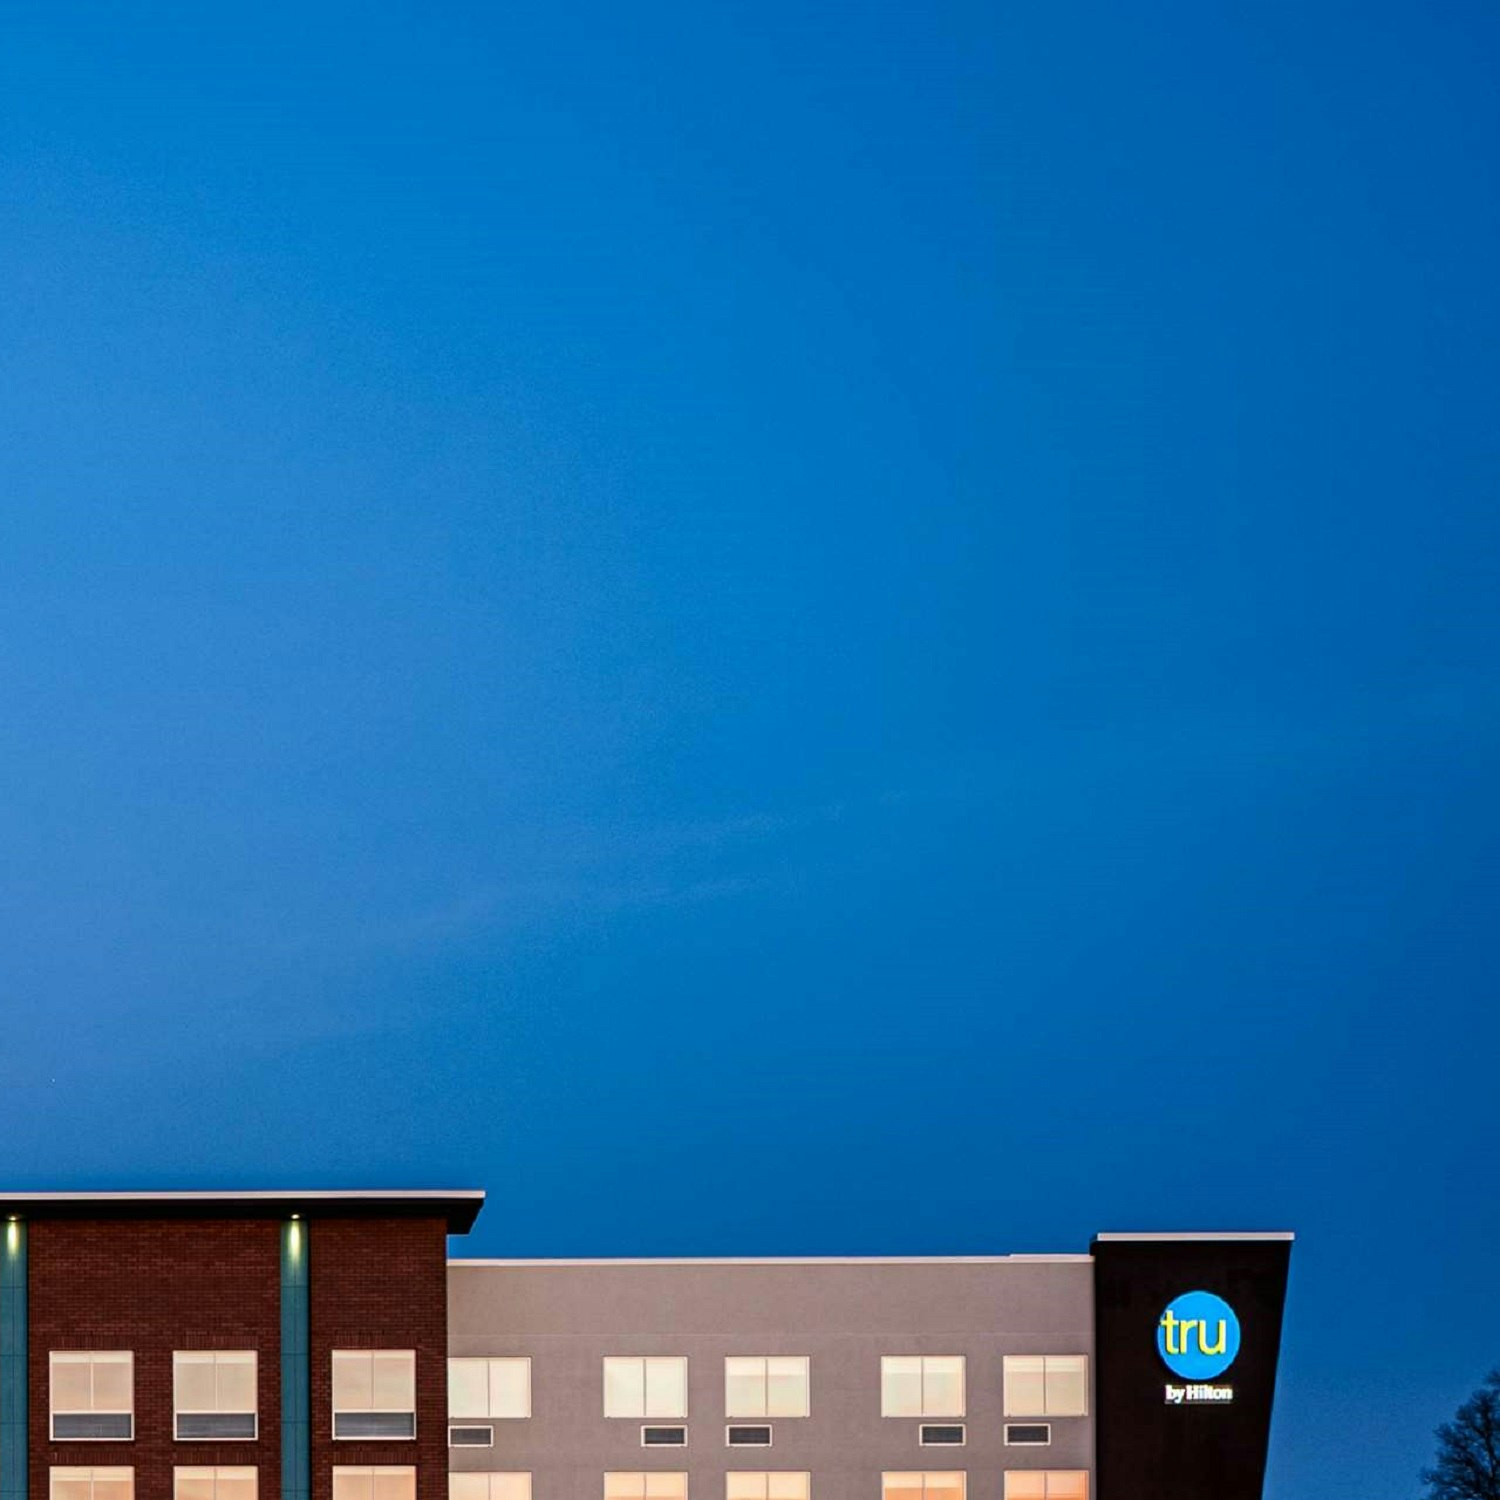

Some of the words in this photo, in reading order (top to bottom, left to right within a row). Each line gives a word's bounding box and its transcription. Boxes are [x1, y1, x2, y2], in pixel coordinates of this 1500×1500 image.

[1161, 1309, 1226, 1355] tru
[1165, 1384, 1185, 1404] by
[1185, 1384, 1233, 1401] Hilton
